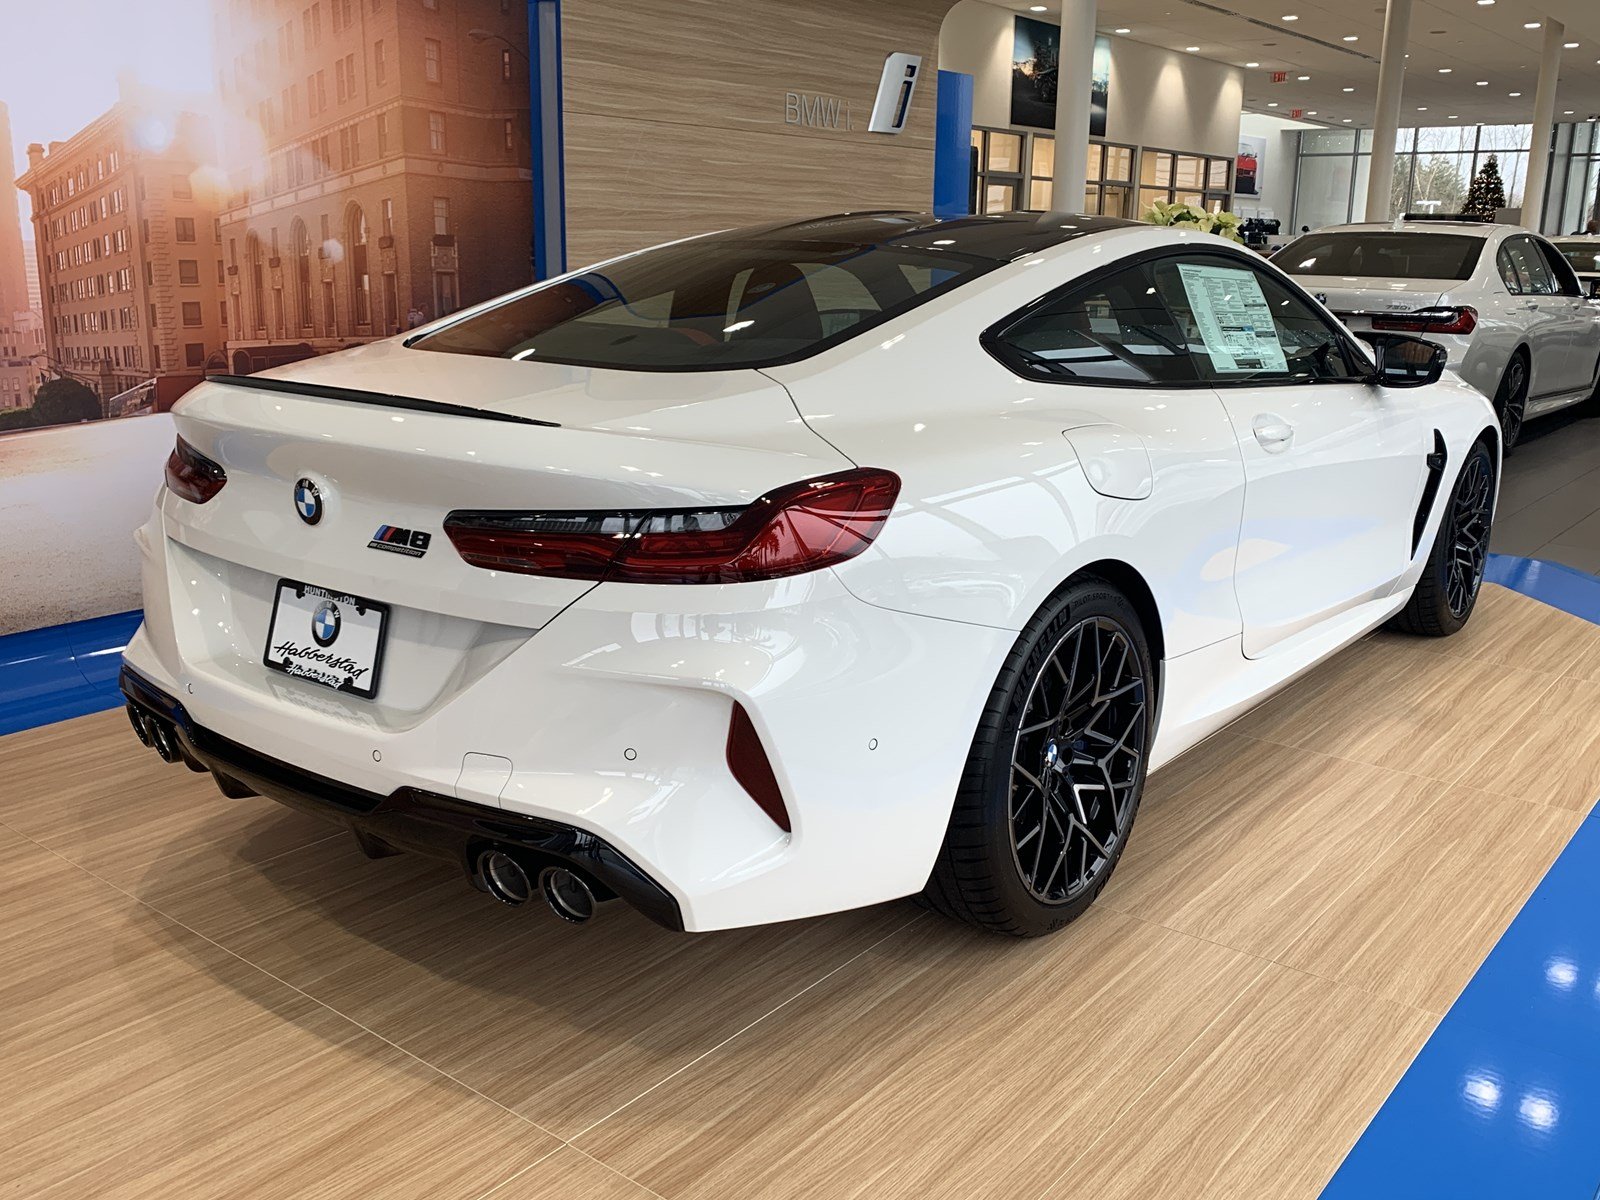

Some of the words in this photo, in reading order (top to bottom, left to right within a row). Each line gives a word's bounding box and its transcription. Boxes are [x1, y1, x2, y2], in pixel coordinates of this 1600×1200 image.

[1273, 71, 1287, 82] EXIT
[785, 92, 841, 129] BMW
[1291, 109, 1303, 118] EXIT
[376, 525, 432, 550] M8
[274, 641, 369, 679] Habberstad
[1012, 607, 1069, 711] MICHELIN
